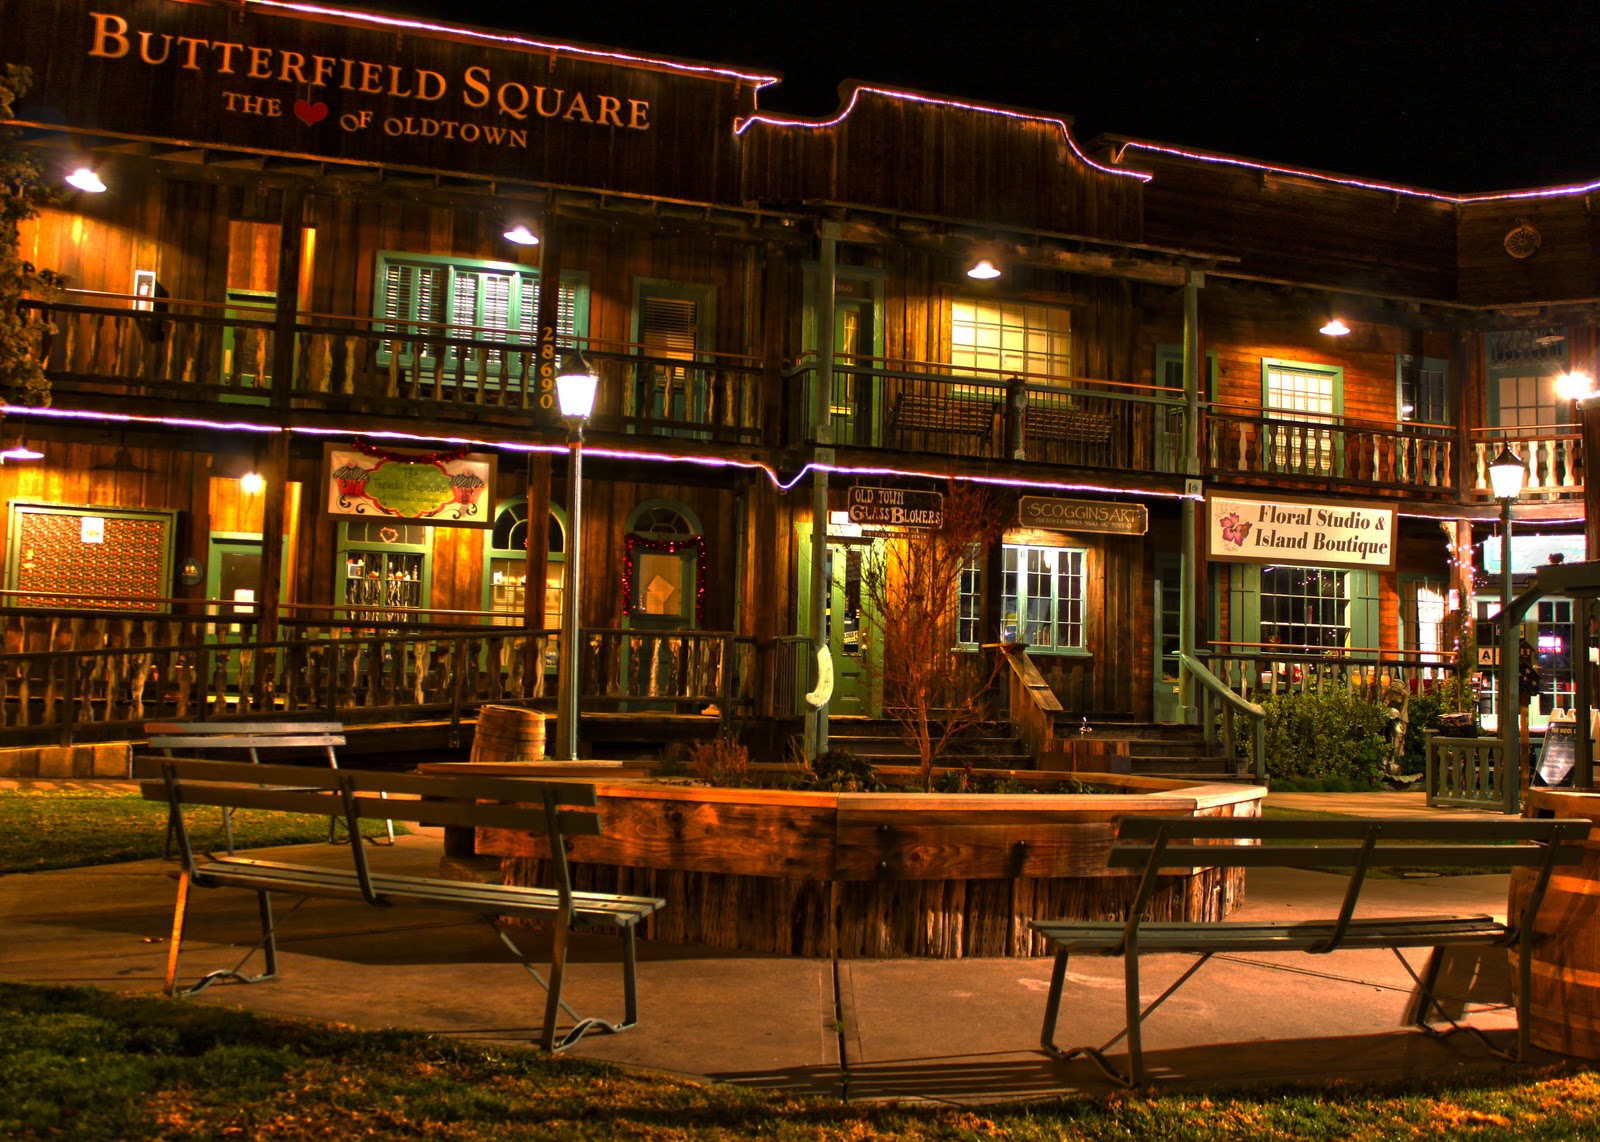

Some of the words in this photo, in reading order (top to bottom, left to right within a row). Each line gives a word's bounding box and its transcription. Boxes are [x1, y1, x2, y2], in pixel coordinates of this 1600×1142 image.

[88, 12, 448, 103] BUTTERFIELD
[462, 65, 652, 132] SQUARE
[222, 90, 283, 119] THE
[339, 111, 375, 134] OF
[383, 115, 529, 150] OLDTOWN
[539, 326, 554, 409] 28690
[402, 467, 420, 480] The
[372, 478, 403, 494] Trendy
[407, 480, 448, 495] Cupcake
[855, 489, 874, 503] OLD
[878, 490, 904, 505] TOWN
[1029, 502, 1109, 521] SCOGGINS
[1109, 508, 1138, 523] ART
[1258, 504, 1313, 526] Floral
[1316, 508, 1371, 530] Studio
[1374, 516, 1386, 531] &
[1254, 528, 1309, 550] Island
[1312, 532, 1388, 560] Boutique
[1482, 650, 1491, 660] A
